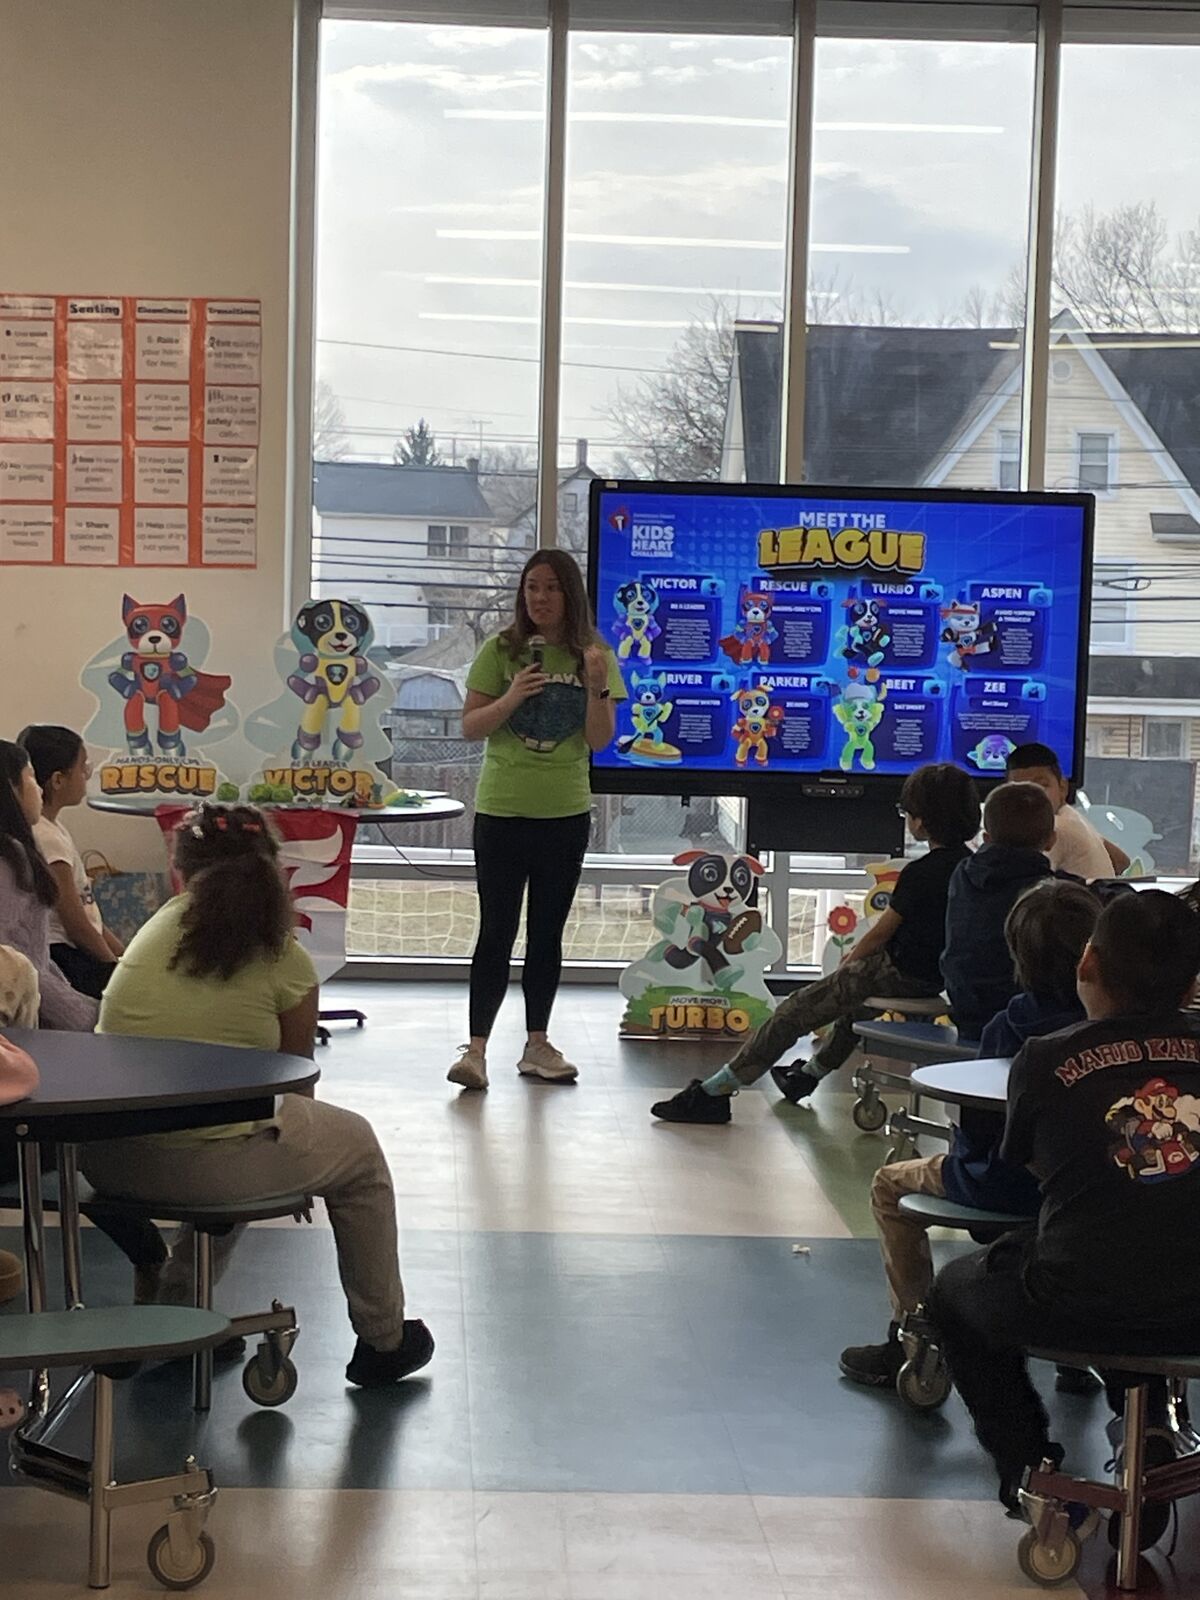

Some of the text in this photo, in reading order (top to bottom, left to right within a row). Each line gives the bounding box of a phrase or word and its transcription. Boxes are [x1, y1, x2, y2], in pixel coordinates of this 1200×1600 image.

[69, 303, 120, 316] Seating
[799, 511, 886, 529] MEET THE
[632, 525, 675, 541] KIDS
[631, 540, 674, 551] HEART
[757, 527, 926, 575] LEAGUE
[651, 578, 698, 590] VICTOR
[759, 580, 809, 593] RESCUE
[871, 583, 915, 595] TURBO
[981, 587, 1023, 600] ASPEN
[666, 673, 703, 685] RIVER
[759, 676, 809, 688] PARKER
[885, 679, 916, 691] BEET
[983, 681, 1007, 694] ZEE
[100, 764, 217, 797] RESCUE
[263, 766, 376, 798] VICTOR
[649, 1004, 750, 1033] TURBO
[1054, 1039, 1144, 1088] MARIO
